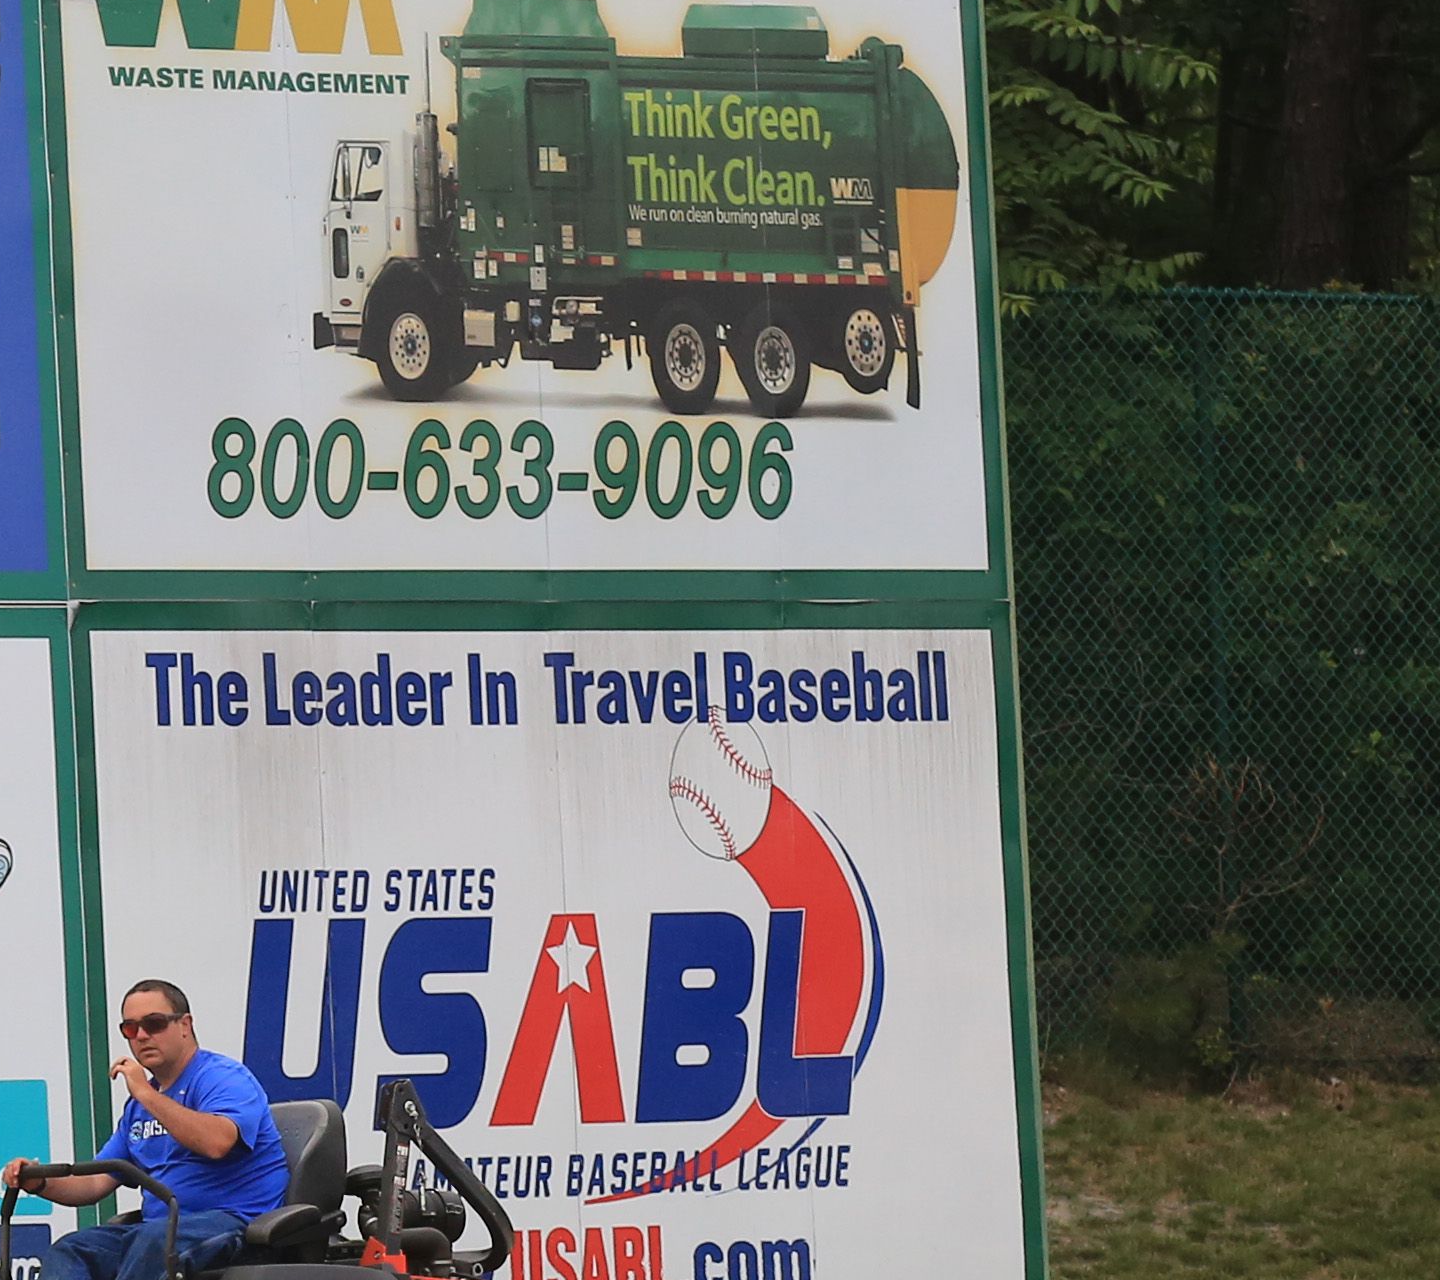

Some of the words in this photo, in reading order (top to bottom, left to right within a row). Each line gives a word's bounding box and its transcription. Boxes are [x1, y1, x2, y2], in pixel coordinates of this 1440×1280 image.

[107, 64, 205, 91] WASTE
[212, 66, 410, 97] MANAGEMENT
[624, 89, 715, 139] Think
[720, 93, 833, 150] Green,
[626, 153, 718, 204] Think
[723, 156, 826, 207] Clean.
[830, 176, 874, 201] WM
[628, 204, 647, 221] We
[649, 208, 668, 221] run
[669, 208, 684, 222] on
[686, 206, 715, 222] clean
[760, 208, 799, 225] natural
[801, 212, 824, 230] gas.
[206, 416, 795, 521] 800-633-9096
[144, 651, 249, 727] The
[264, 652, 453, 727] Leader
[467, 651, 518, 727] In
[543, 651, 710, 726] Travel
[722, 650, 950, 724] Baseball
[259, 870, 369, 914] UNITED
[382, 868, 496, 912] STATES
[241, 910, 856, 1128] USABL
[566, 1148, 722, 1197] BASEBALL
[737, 1145, 851, 1191] LEAGUE
